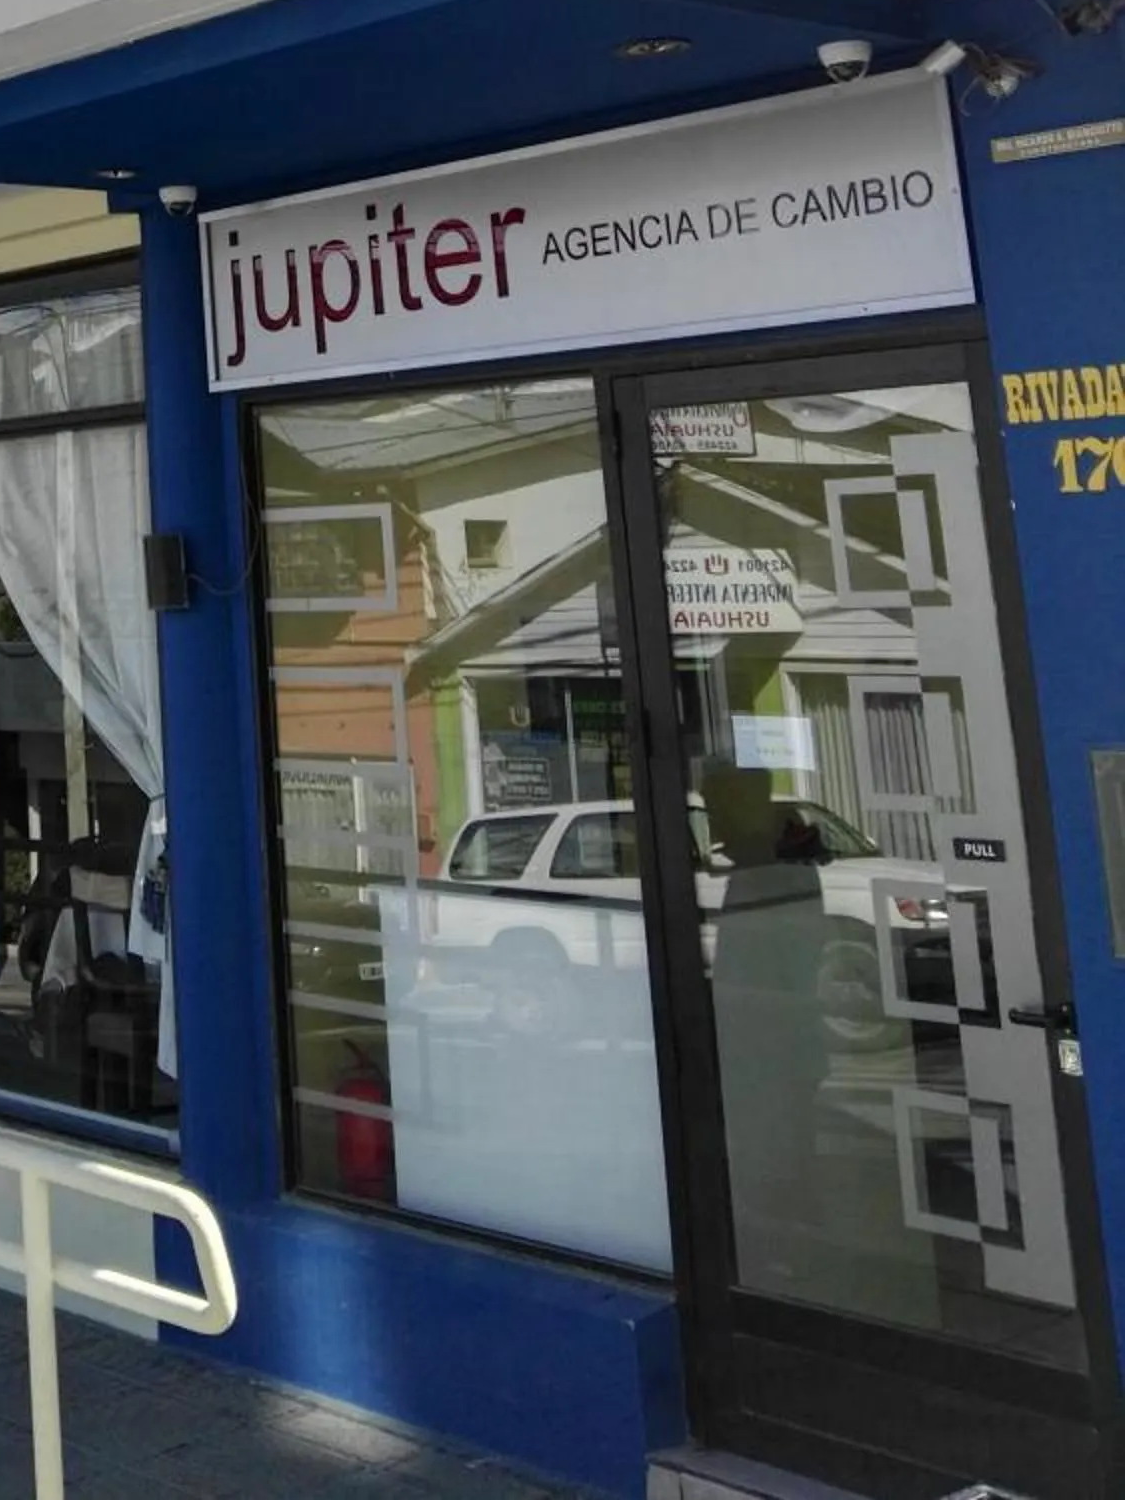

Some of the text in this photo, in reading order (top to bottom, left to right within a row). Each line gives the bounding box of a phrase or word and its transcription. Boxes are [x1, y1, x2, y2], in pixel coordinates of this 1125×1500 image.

[226, 169, 934, 367] jupiter AGENCIA DE CAMBIO
[1002, 363, 1125, 425] RIVADA
[964, 842, 996, 858] PULL
